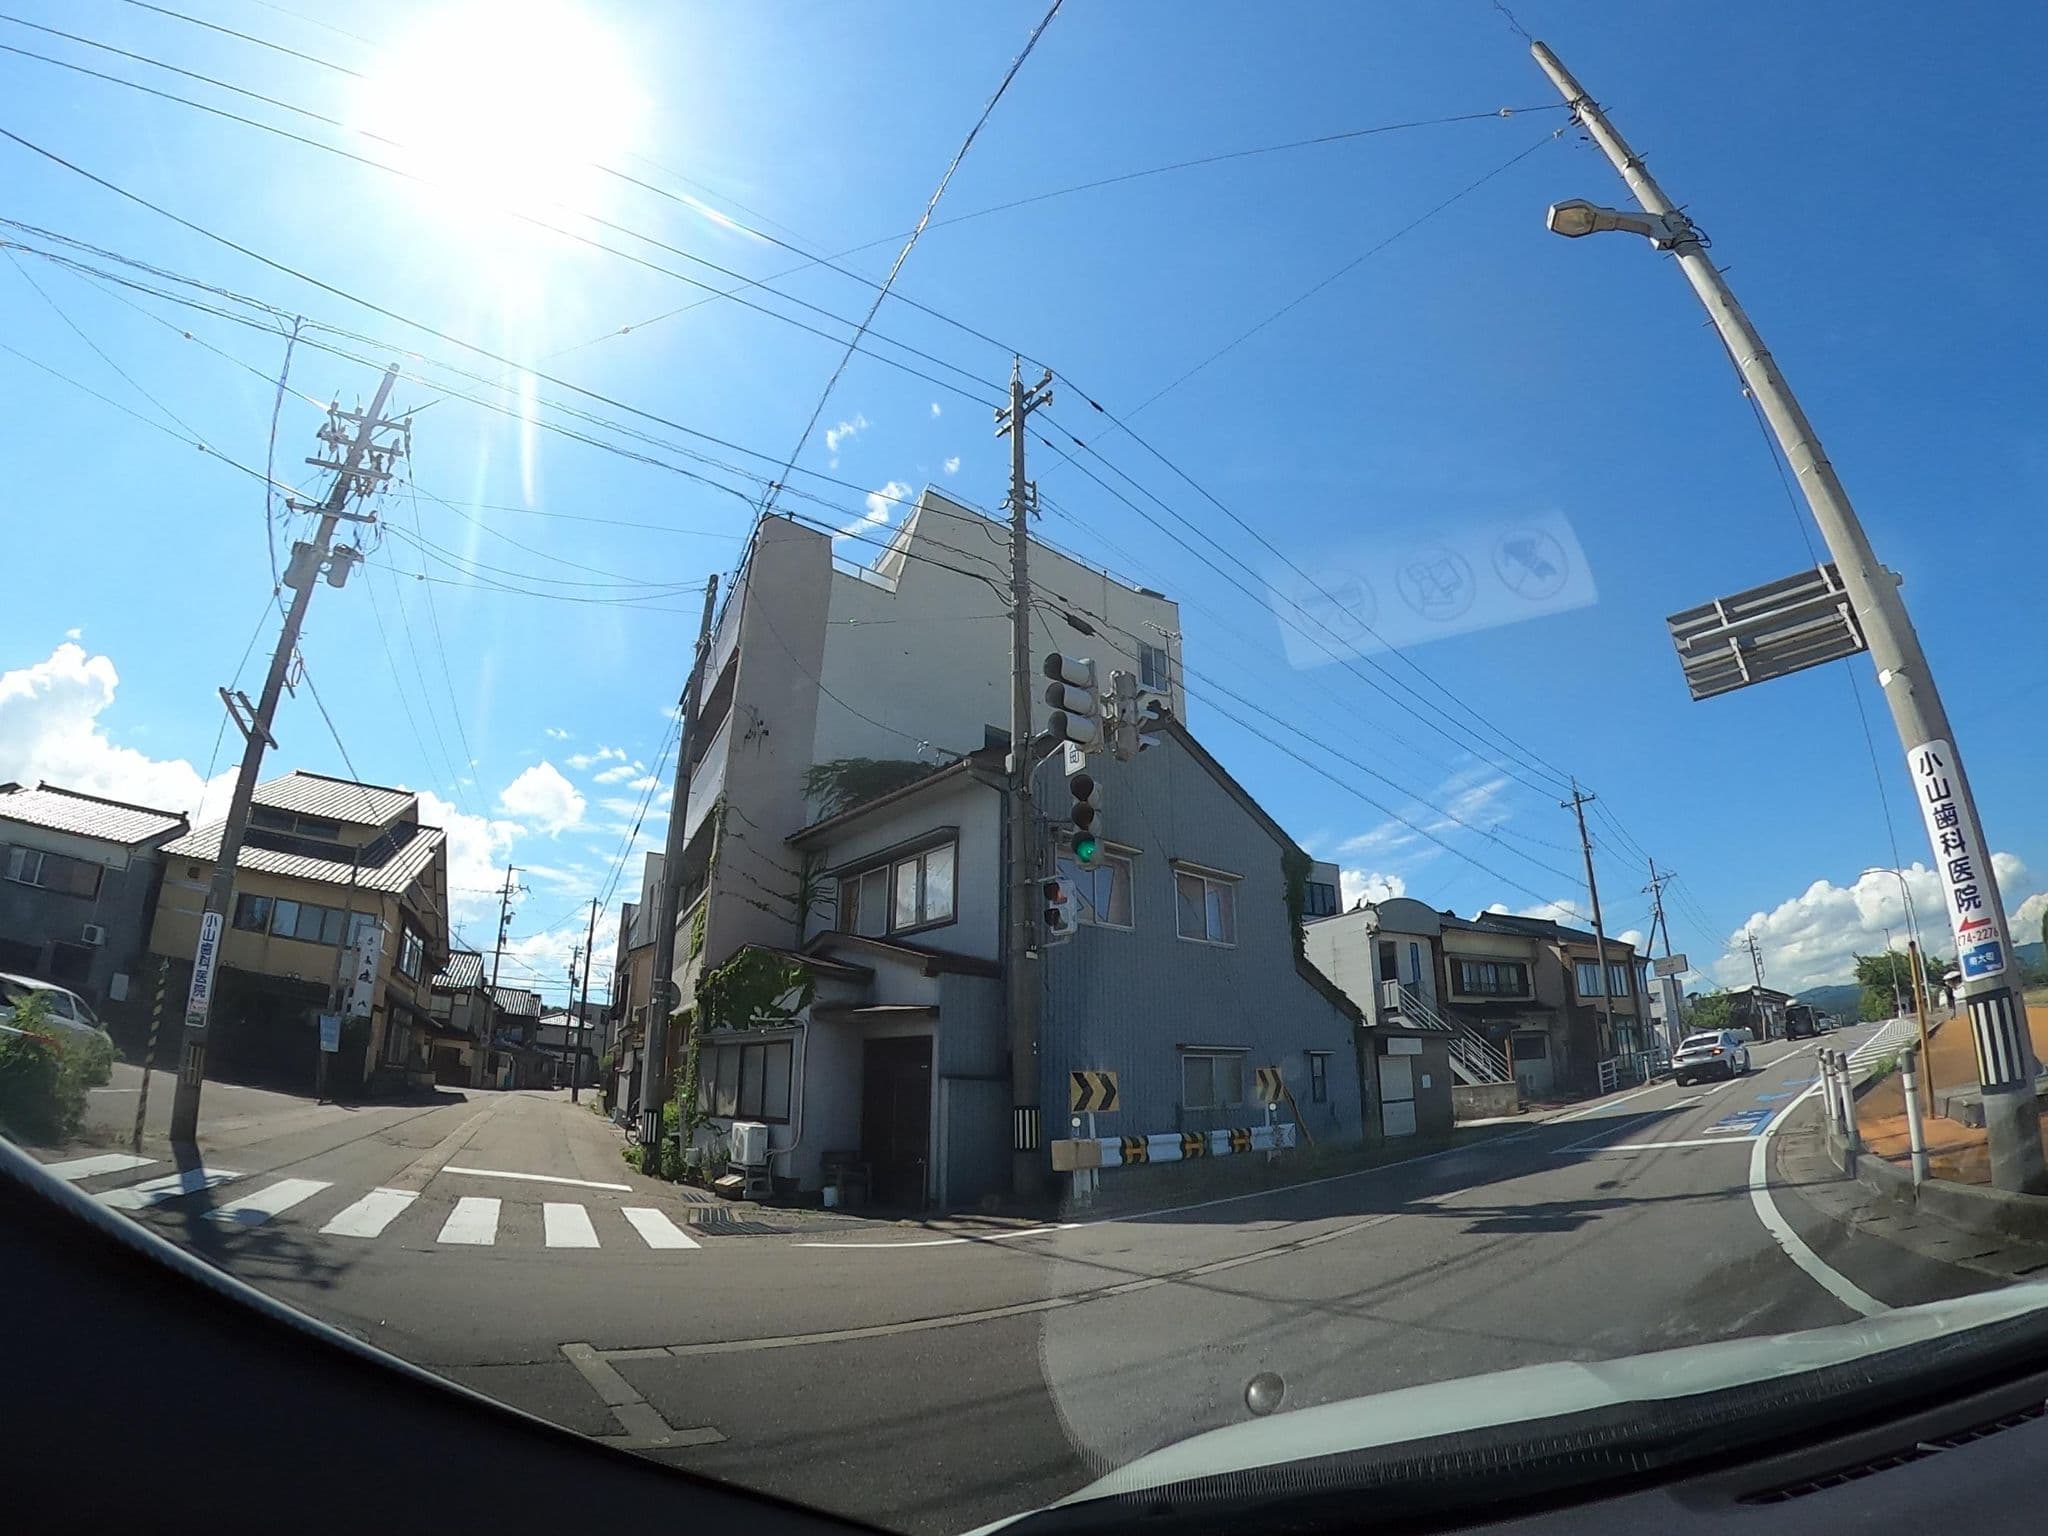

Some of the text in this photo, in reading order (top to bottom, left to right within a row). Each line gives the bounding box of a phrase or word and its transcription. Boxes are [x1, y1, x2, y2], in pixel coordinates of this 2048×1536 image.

[1919, 750, 1983, 914] 小山歯科医院
